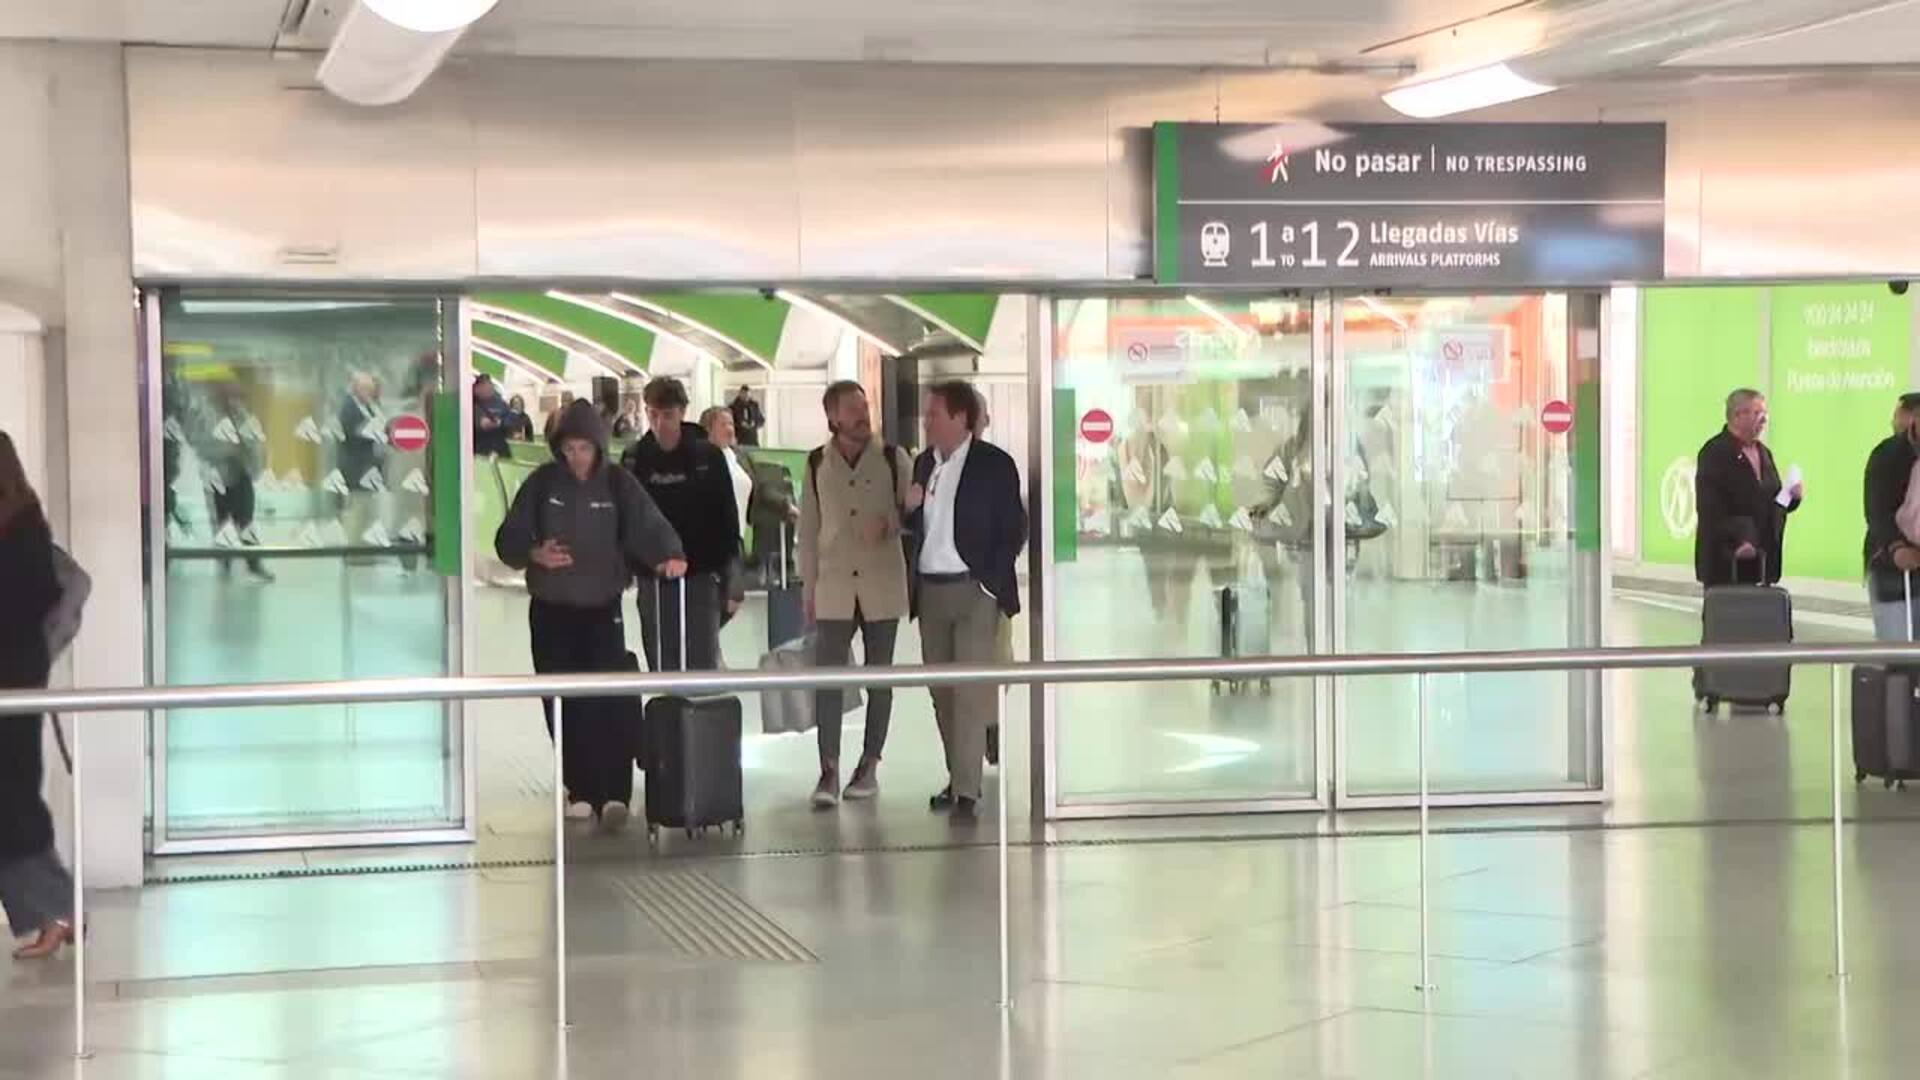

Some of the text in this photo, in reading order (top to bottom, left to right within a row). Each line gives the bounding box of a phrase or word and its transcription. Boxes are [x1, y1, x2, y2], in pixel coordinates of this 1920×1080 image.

[1315, 149, 1587, 177] No pasar NO TRESPASSING
[1250, 220, 1360, 267] 1 a 12
[1370, 219, 1519, 248] Llegadas Vías
[1280, 254, 1295, 267] TO
[1369, 252, 1500, 267] ARRIVALS PLATFORMS
